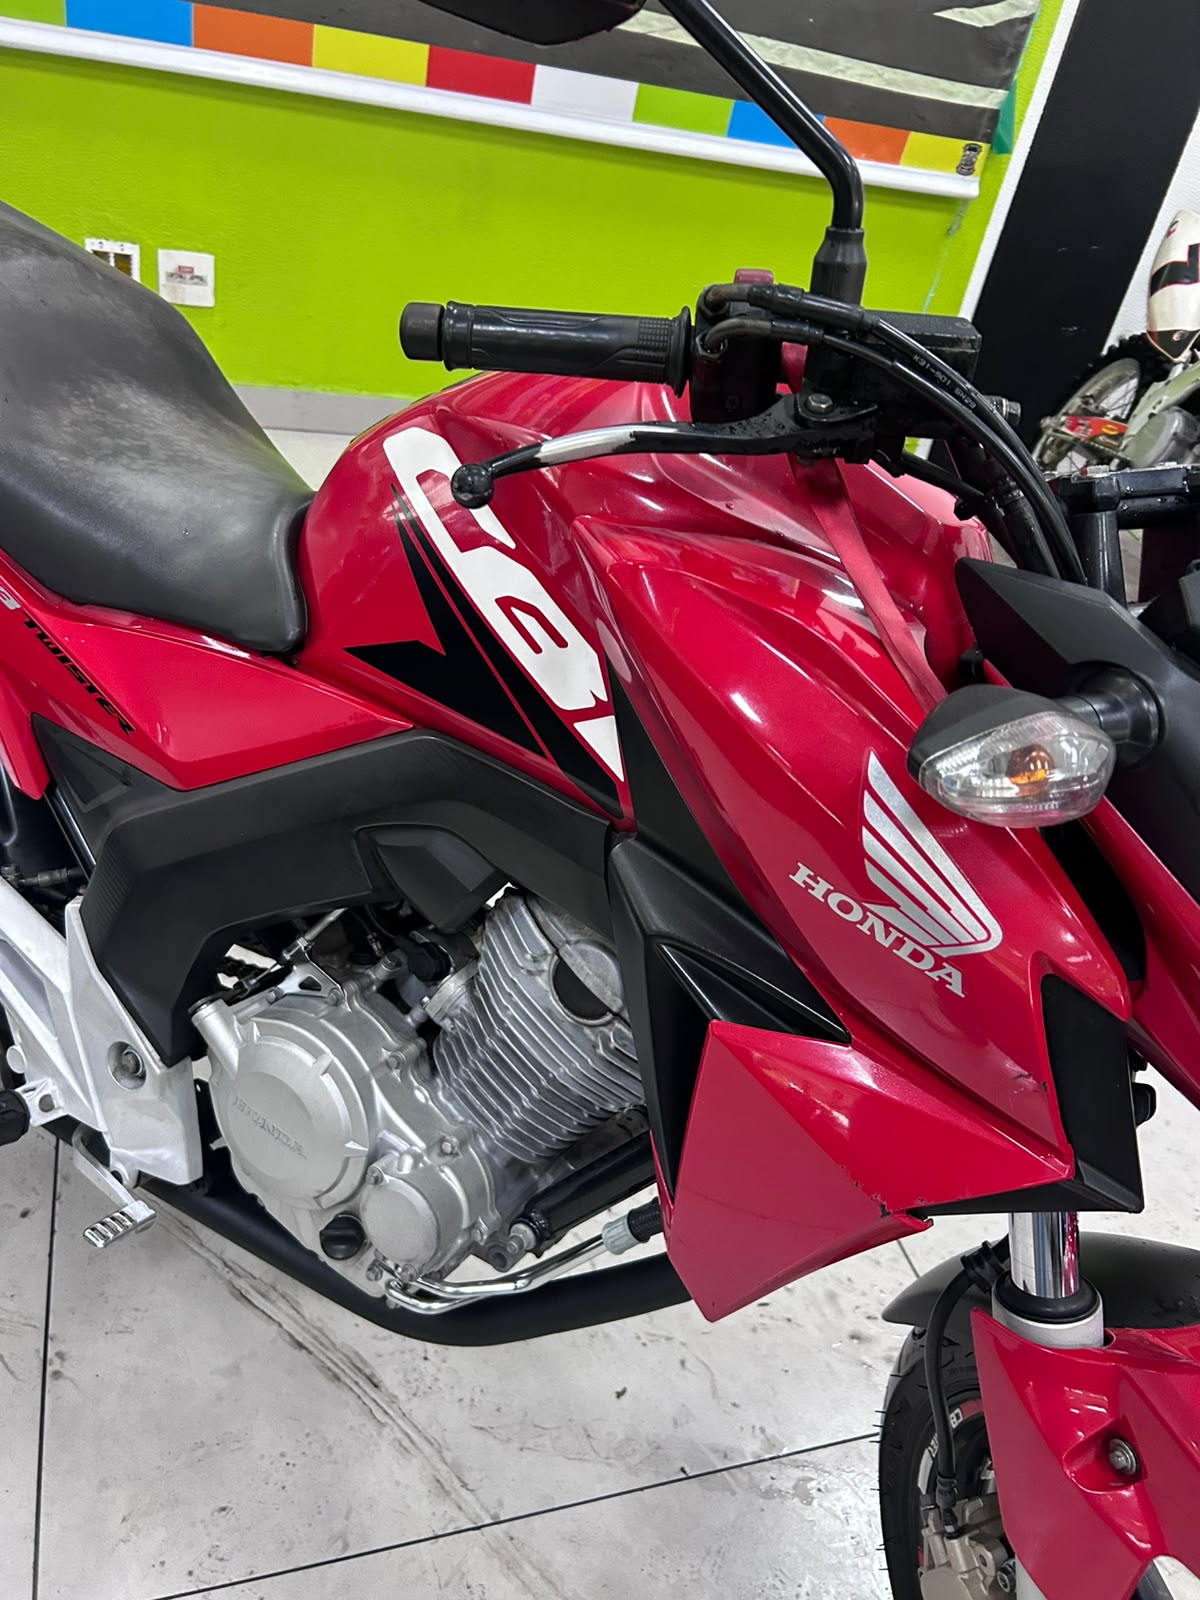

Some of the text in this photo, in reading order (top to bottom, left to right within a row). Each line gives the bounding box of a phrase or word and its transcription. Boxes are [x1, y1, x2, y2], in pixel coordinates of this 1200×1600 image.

[23, 613, 136, 737] TWISTER
[788, 862, 968, 998] HONDA
[231, 1095, 309, 1161] HONDA
